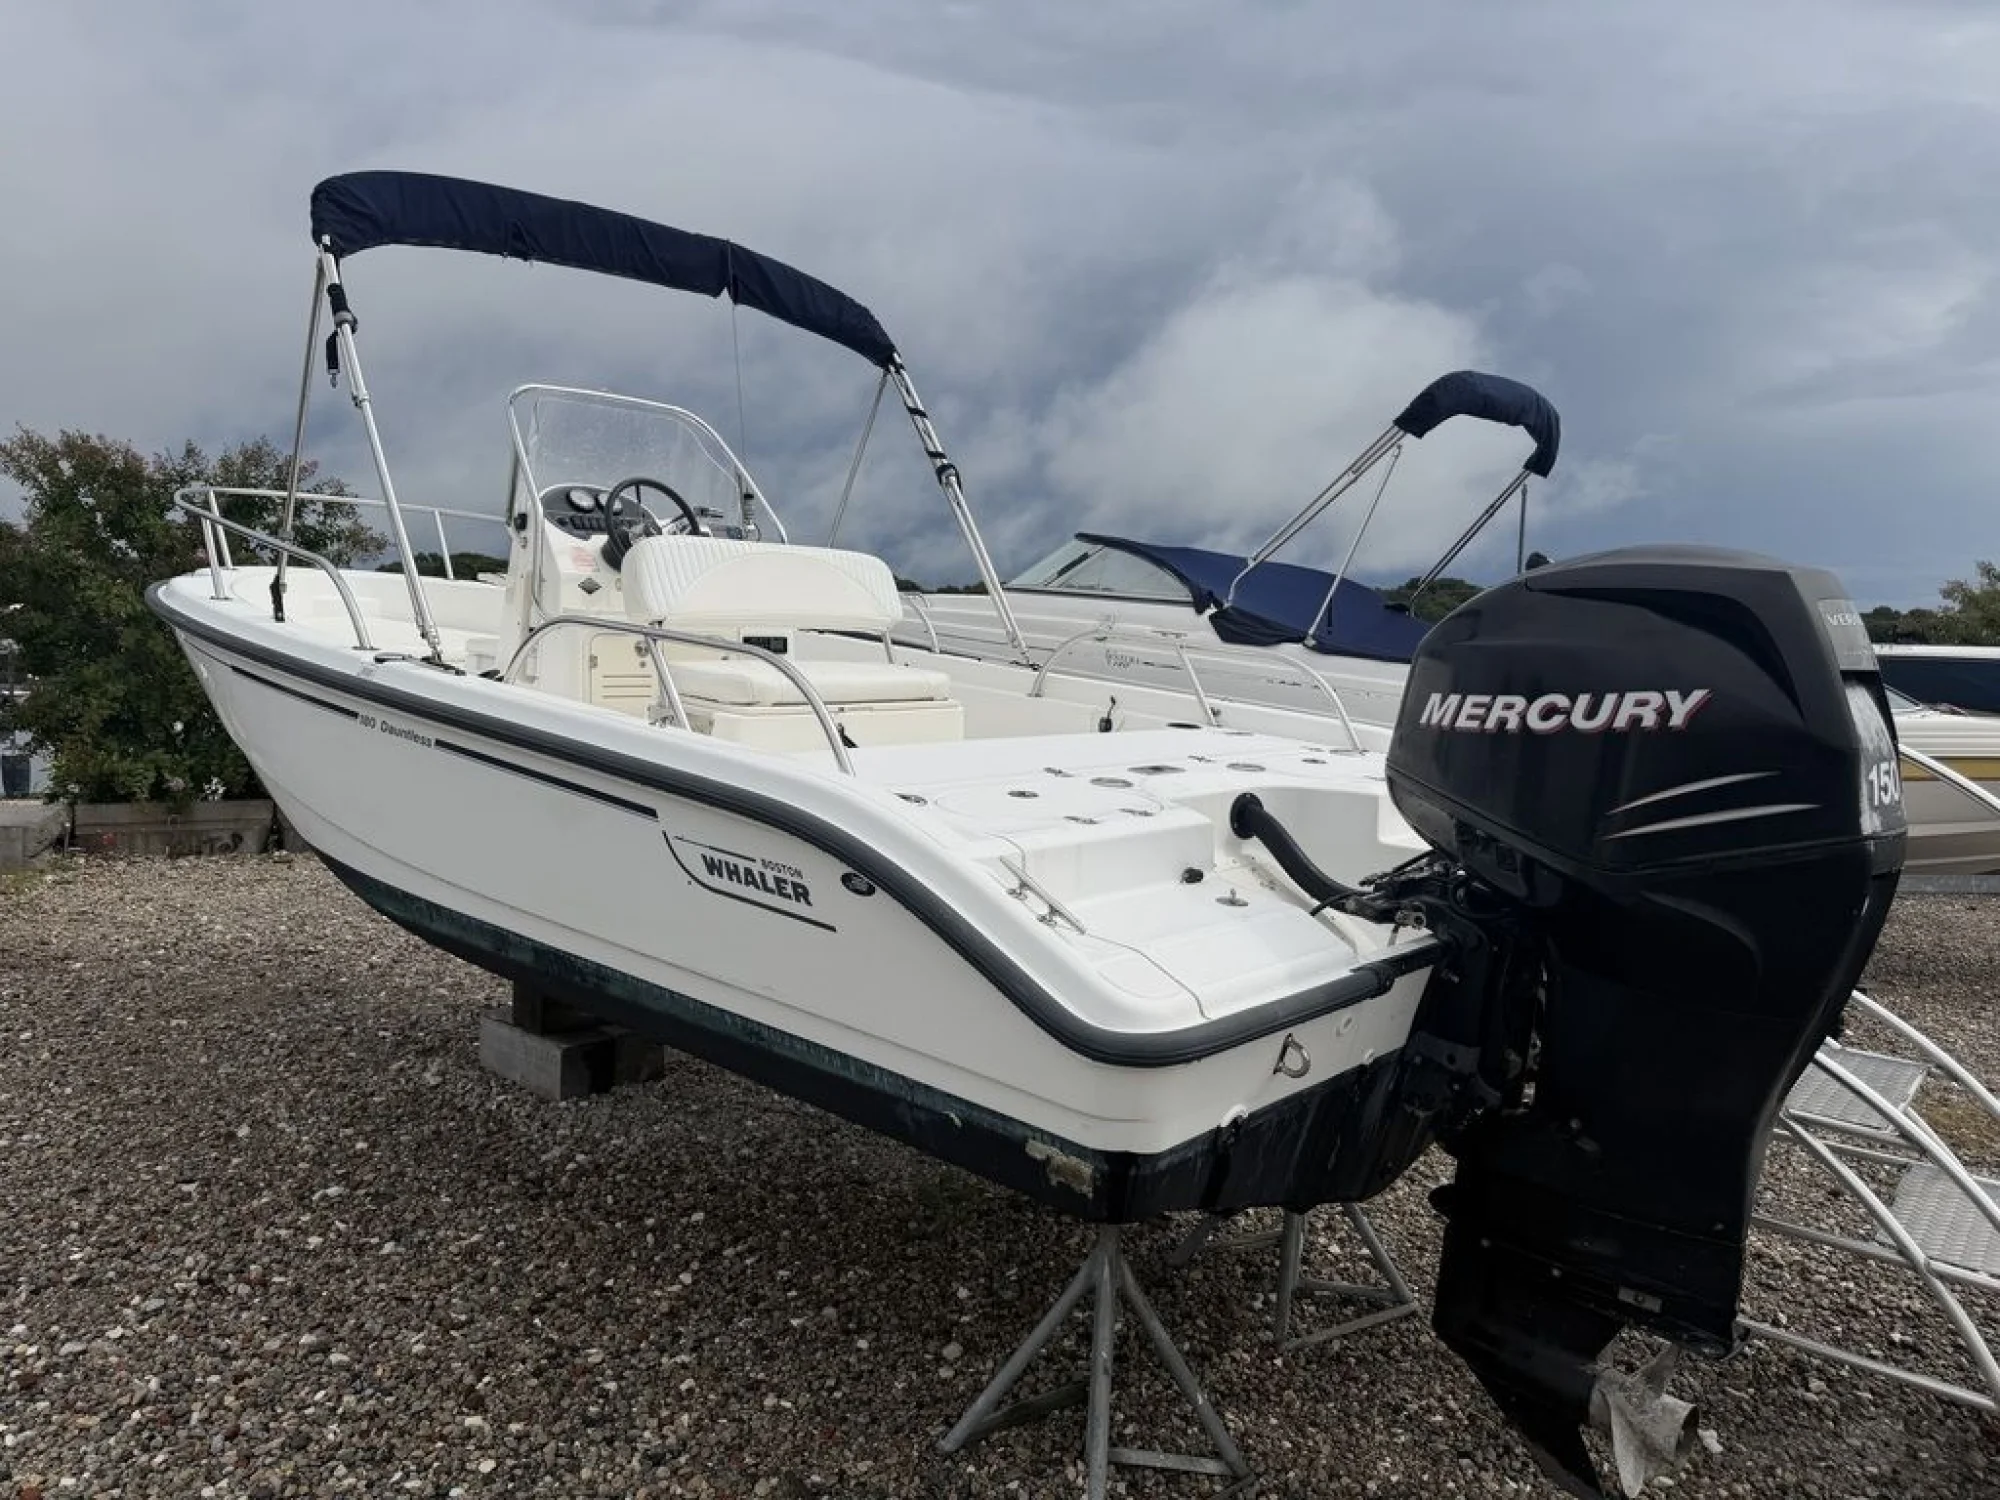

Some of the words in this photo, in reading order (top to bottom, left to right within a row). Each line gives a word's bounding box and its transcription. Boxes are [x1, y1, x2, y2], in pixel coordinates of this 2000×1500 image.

[359, 714, 376, 729] 180
[380, 720, 432, 748] Dauntless
[1419, 688, 1713, 732] MERCURY
[1868, 761, 1900, 806] 150
[701, 853, 813, 906] WHALER
[761, 858, 804, 880] BOSTON
